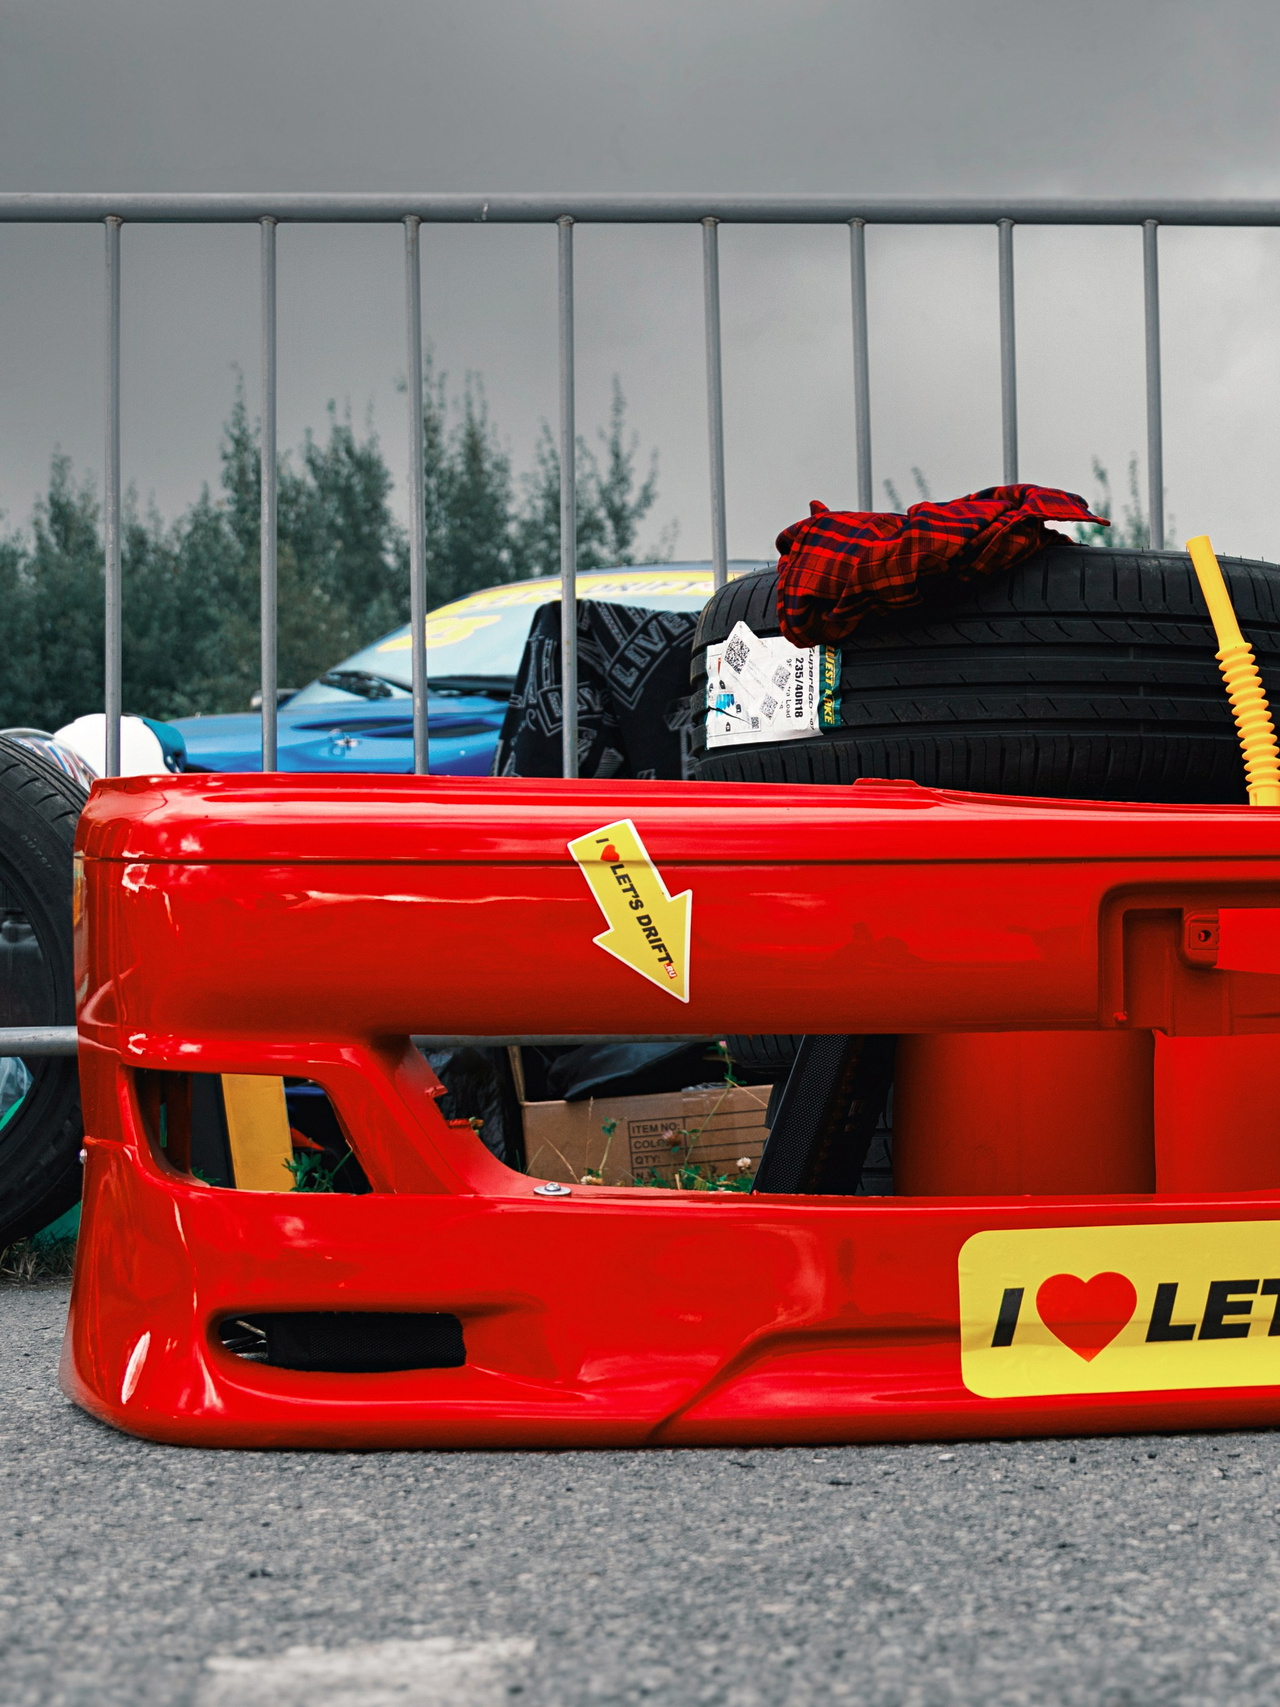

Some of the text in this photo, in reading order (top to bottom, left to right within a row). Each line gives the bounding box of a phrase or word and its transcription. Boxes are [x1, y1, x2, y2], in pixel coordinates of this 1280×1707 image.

[611, 611, 690, 688] LIVE
[794, 657, 804, 718] 235/40R18
[632, 1122, 680, 1134] ITEM NO:
[635, 1154, 661, 1165] QTY:
[991, 1287, 1025, 1347] I
